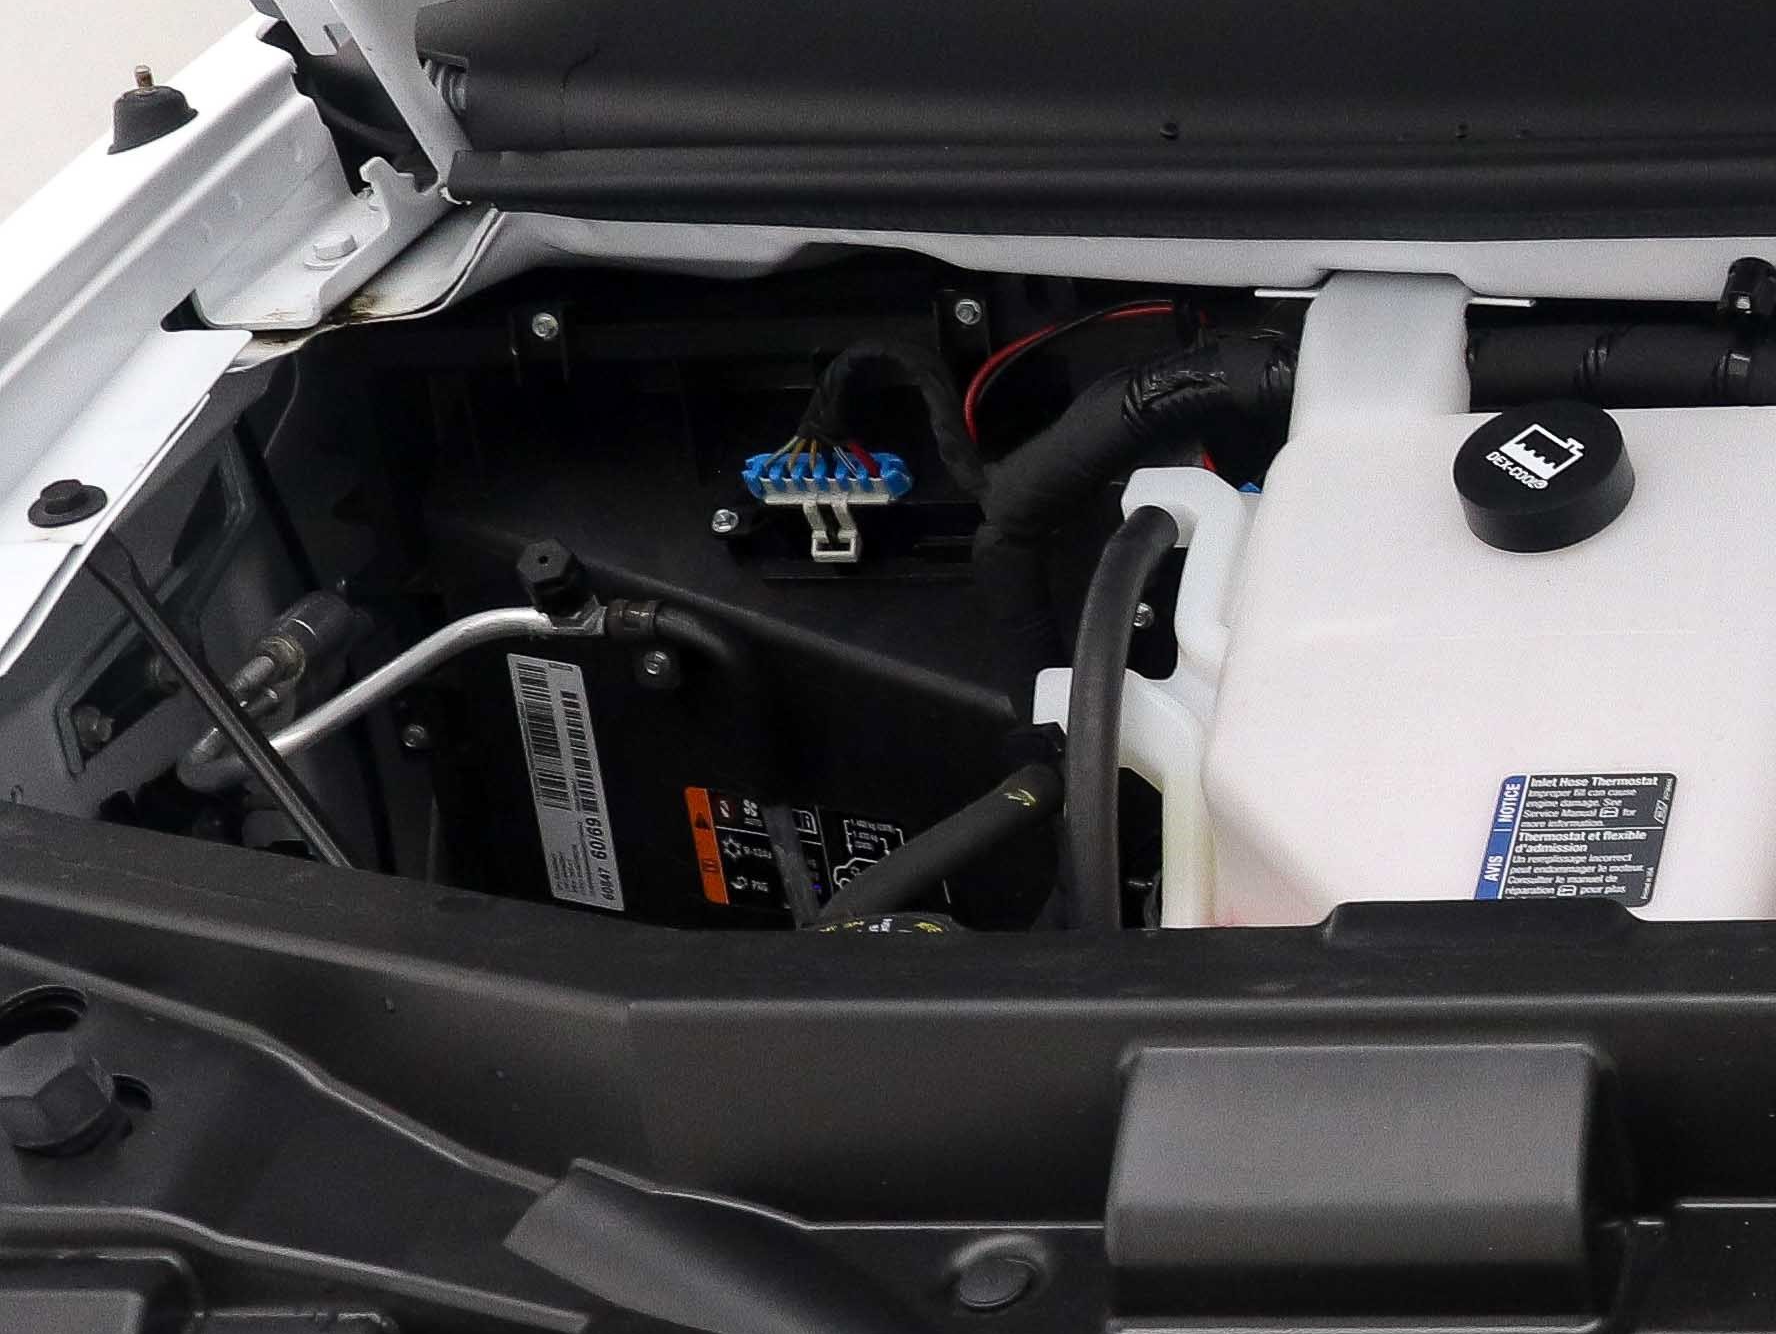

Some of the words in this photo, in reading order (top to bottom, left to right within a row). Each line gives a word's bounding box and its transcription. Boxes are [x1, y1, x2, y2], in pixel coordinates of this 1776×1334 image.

[1530, 777, 1558, 787] Inlet
[1559, 777, 1589, 787] Hose
[1592, 776, 1659, 786] Thermostat
[1528, 789, 1572, 798] Improper
[1499, 783, 1521, 823] NOTICE
[1602, 797, 1622, 807] See
[1522, 809, 1560, 818] Service
[1560, 808, 1597, 817] Manual
[585, 816, 608, 862] 60/69
[1519, 831, 1586, 841] Thermostat
[1587, 831, 1601, 841] et
[1602, 830, 1647, 841] flexible
[1511, 855, 1526, 864] Un
[1588, 853, 1633, 862] incorrect
[1484, 856, 1504, 882] AVIS
[1507, 875, 1554, 884] Consulter
[1579, 886, 1603, 895] pour
[1603, 884, 1626, 894] plus
